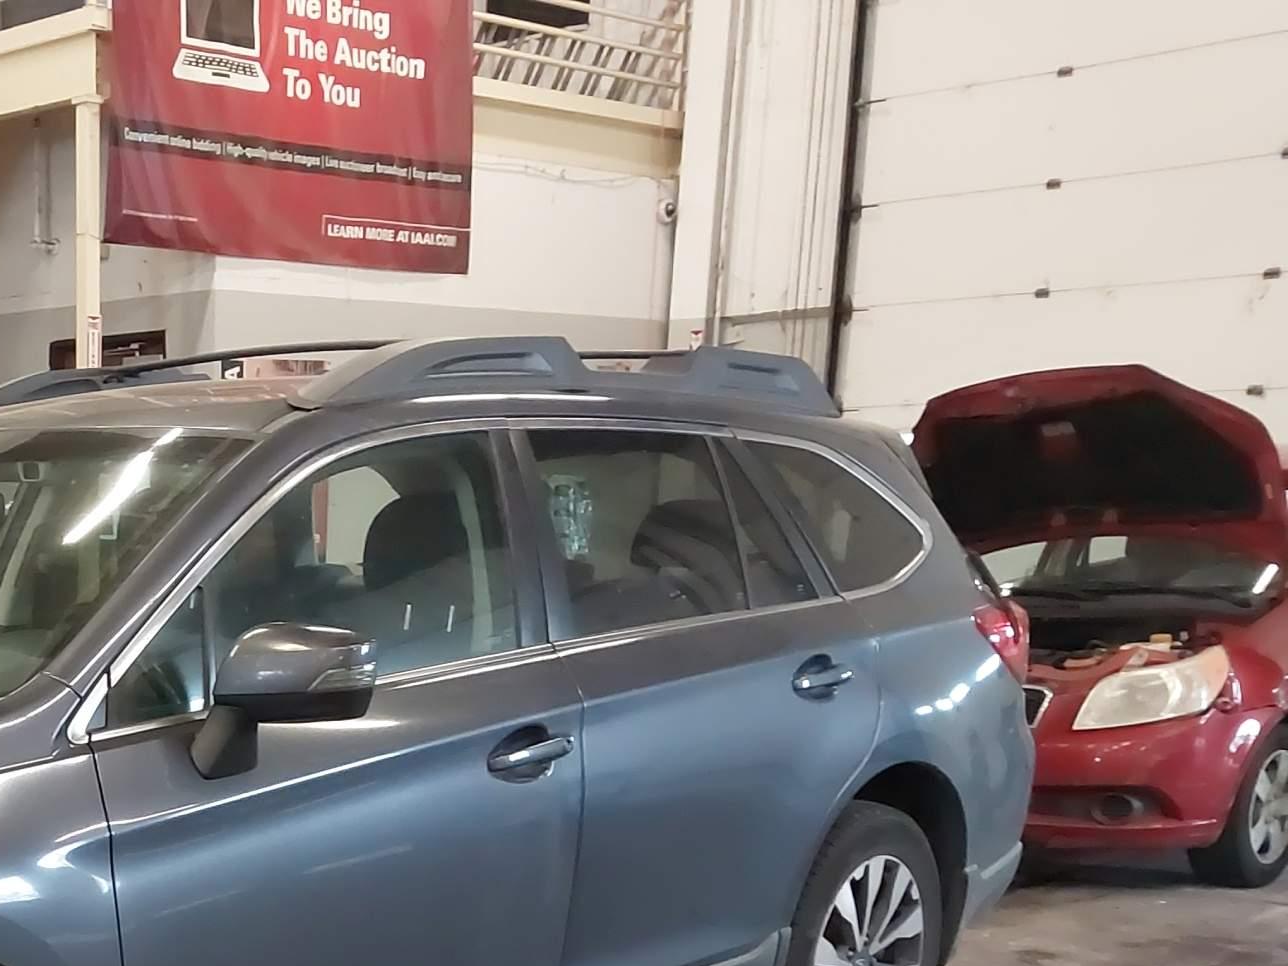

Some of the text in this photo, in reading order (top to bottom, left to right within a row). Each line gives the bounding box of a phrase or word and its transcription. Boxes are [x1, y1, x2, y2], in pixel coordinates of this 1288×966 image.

[326, 0, 391, 40] Bring
[284, 26, 426, 80] The Auction
[282, 67, 361, 108] To You
[327, 223, 364, 239] LEARN
[365, 227, 395, 242] MORE
[396, 230, 410, 243] AT
